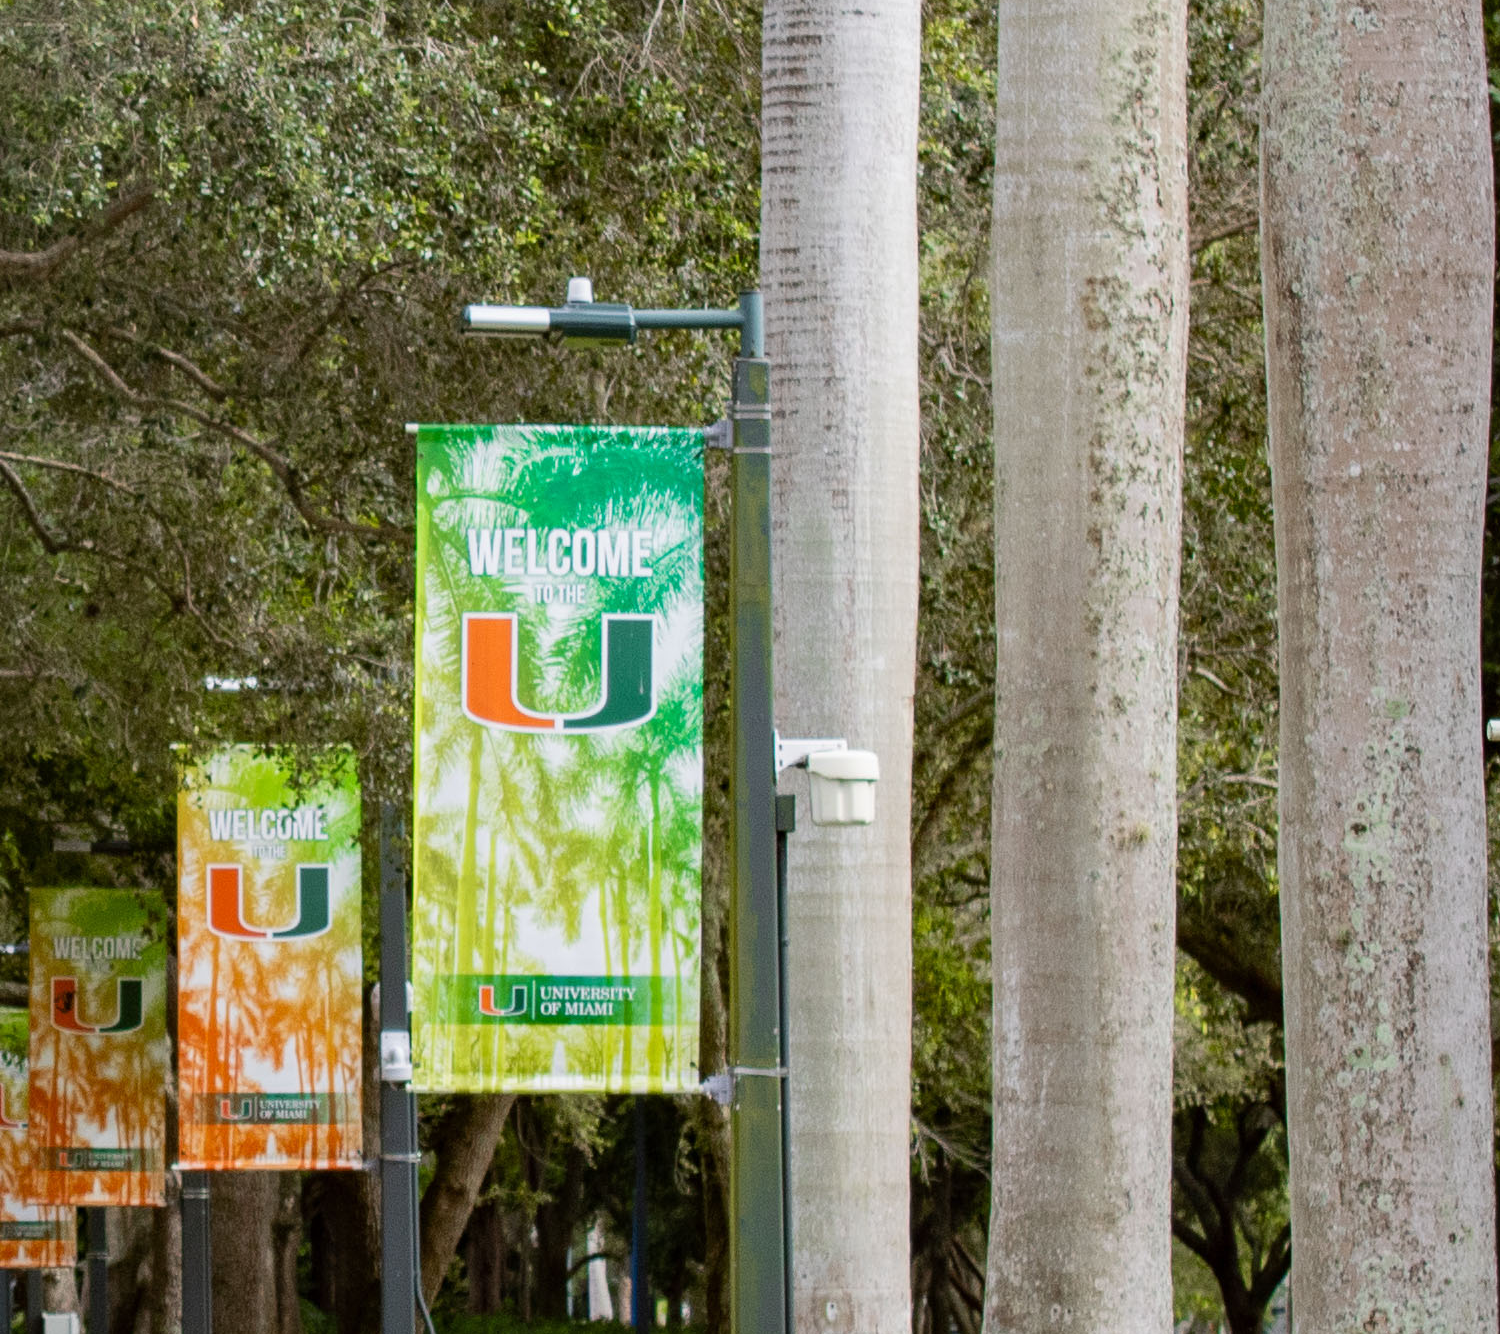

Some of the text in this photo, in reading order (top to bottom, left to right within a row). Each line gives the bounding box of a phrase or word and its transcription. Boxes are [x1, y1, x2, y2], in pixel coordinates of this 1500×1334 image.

[467, 528, 653, 577] WELCOME
[535, 584, 586, 604] TO THE
[461, 611, 658, 733] U
[209, 809, 329, 840] WELCOME
[206, 863, 333, 942] U
[53, 936, 142, 959] WELCOME
[479, 985, 527, 1015] U
[540, 986, 636, 1000] UNIVERSITY
[51, 976, 145, 1035] U
[540, 1002, 613, 1016] OF MIAMI
[220, 1099, 253, 1120] U
[259, 1100, 321, 1109] UNIVERSITY
[259, 1110, 307, 1120] OF MIAMI
